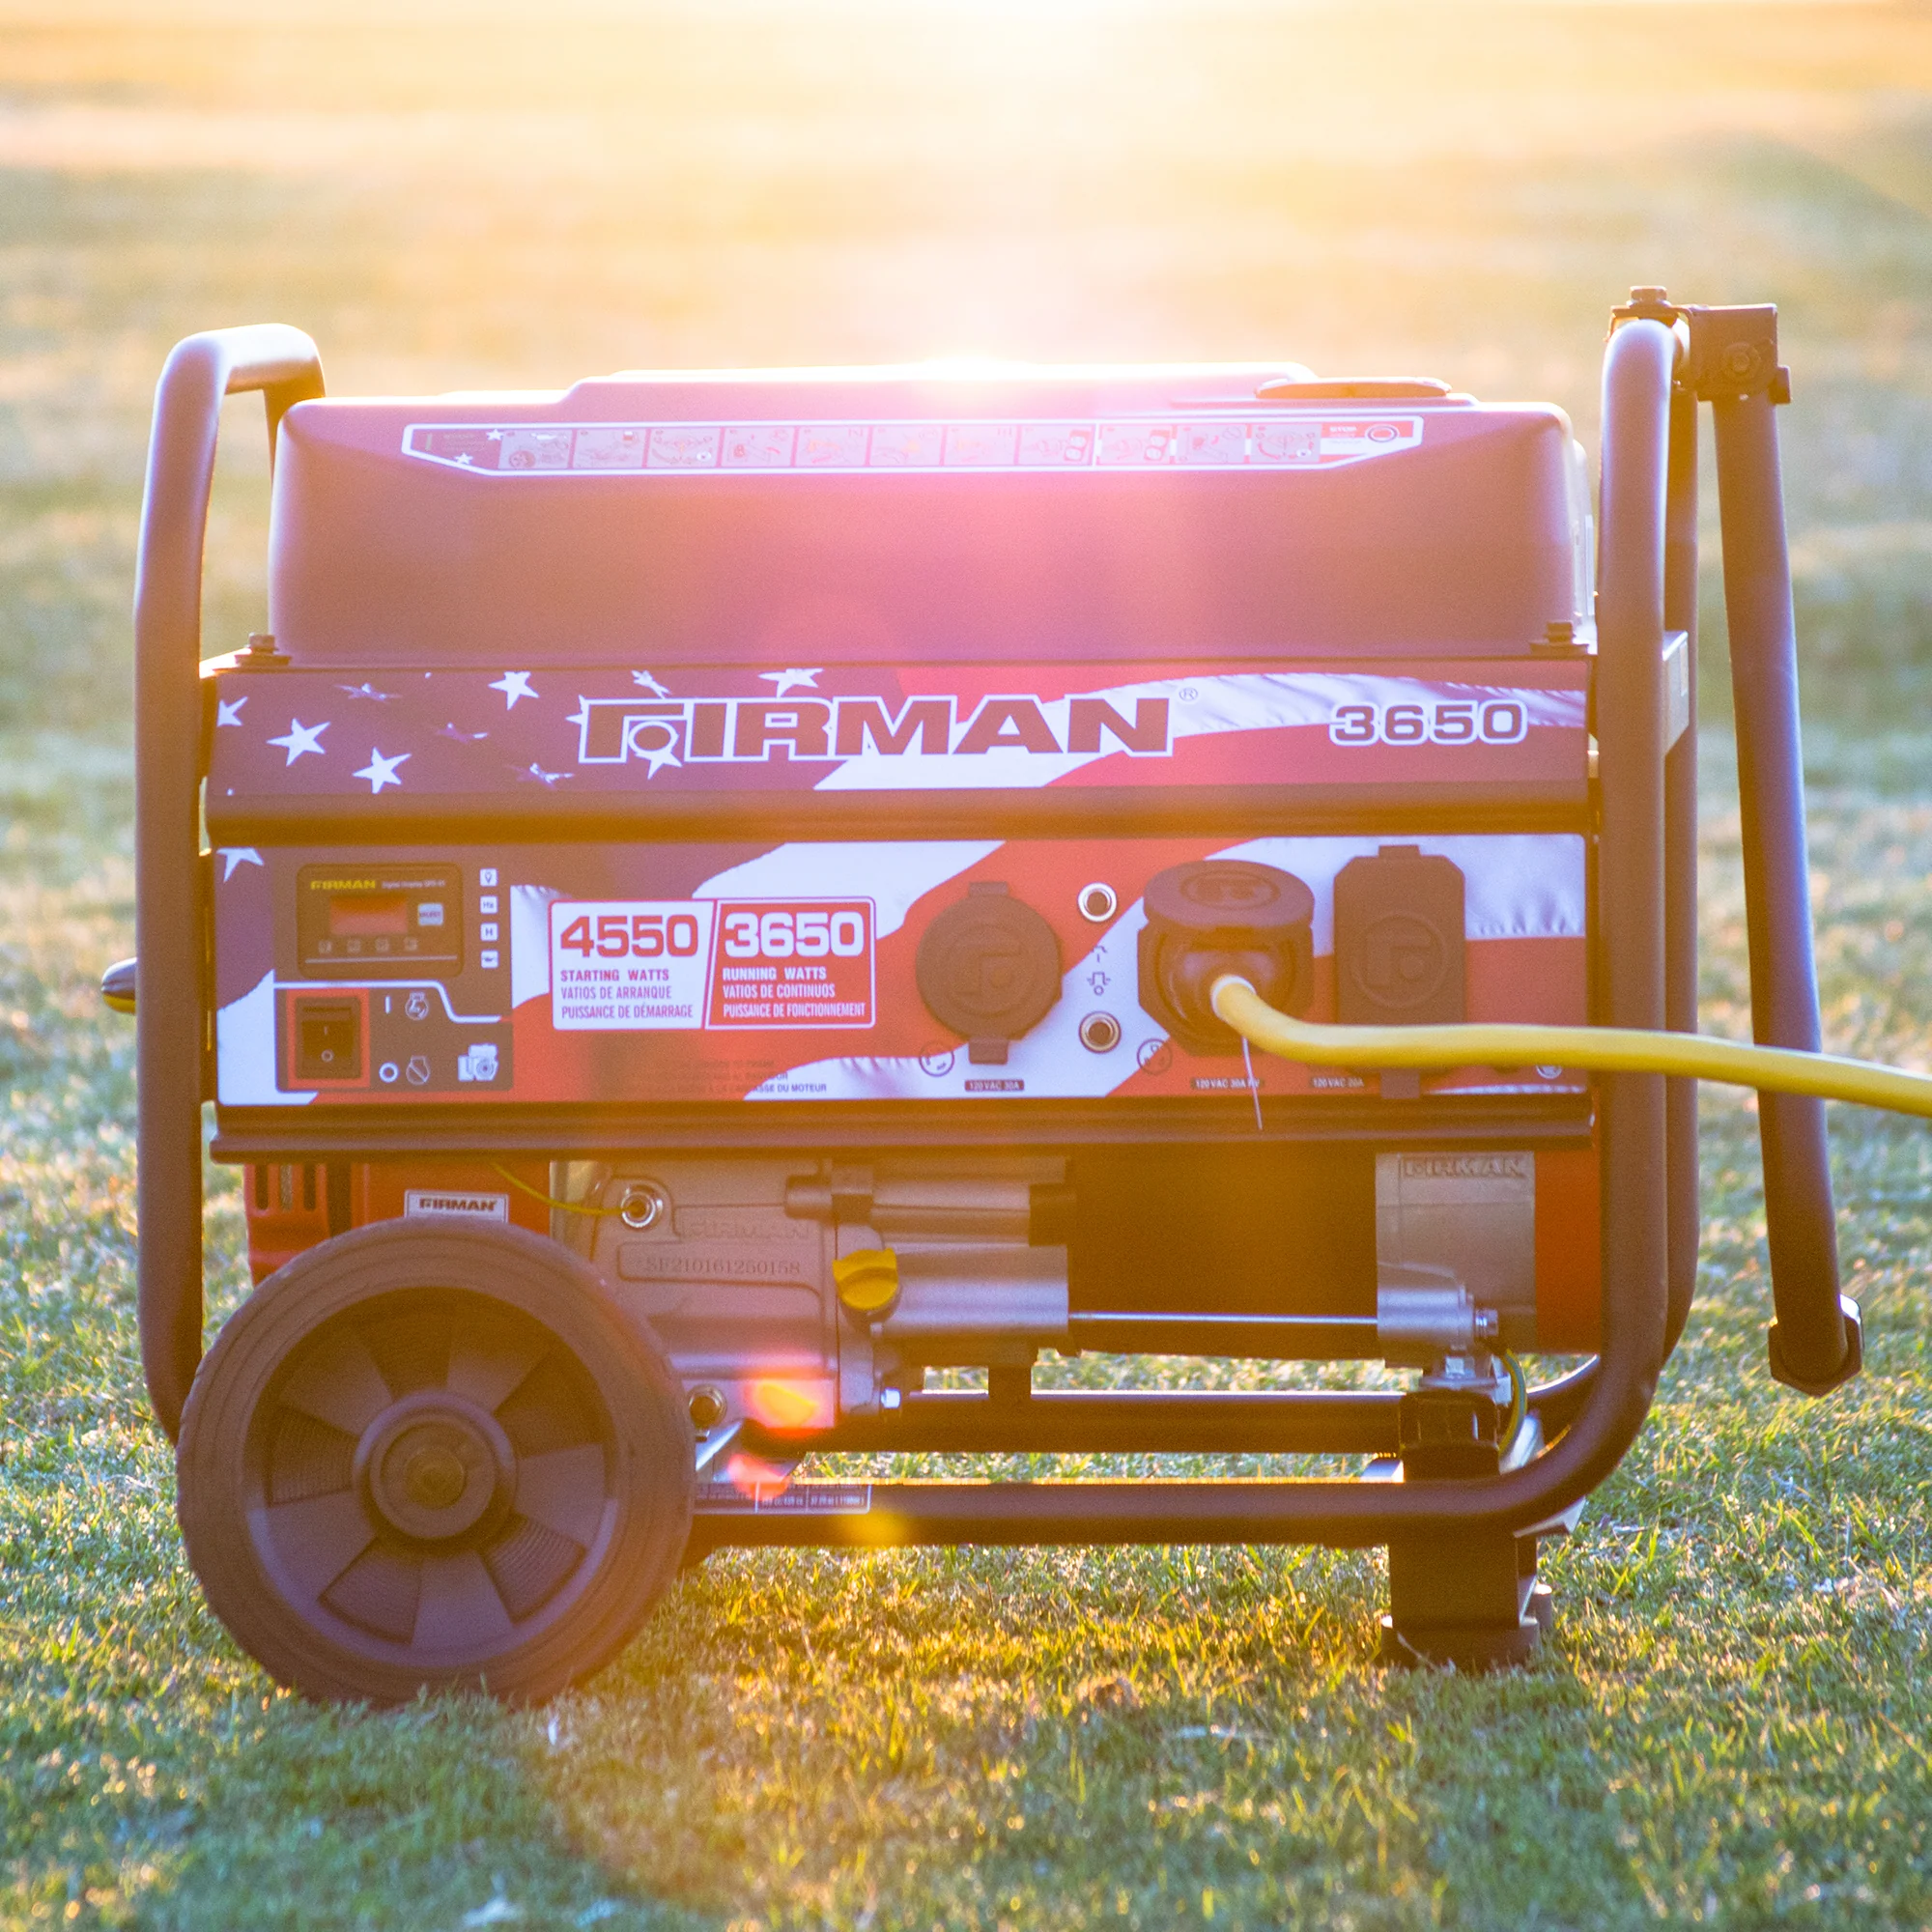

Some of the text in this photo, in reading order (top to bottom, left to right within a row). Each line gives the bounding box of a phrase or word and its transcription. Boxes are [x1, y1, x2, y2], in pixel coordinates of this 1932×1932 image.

[579, 694, 1174, 763] FIRMAN
[1329, 699, 1529, 747] 3650
[310, 880, 376, 890] FIRMAN
[560, 914, 698, 958] 4550
[724, 911, 865, 958] 3650
[560, 969, 669, 982] STARTING WATTS
[723, 966, 827, 980] RUNNING WATTS
[560, 985, 671, 1000] VATIOS DE ARRANQUE
[723, 983, 836, 999] VATIOS DE CONTINUOS
[561, 1002, 693, 1019] PUISSANCE DE DÉMARRAGE
[724, 1002, 866, 1017] PUISSANCE DE FONCTIONNEMENT
[777, 1083, 788, 1093] DU
[791, 1083, 827, 1093] MOTEUR
[419, 1198, 496, 1211] FIRMAN
